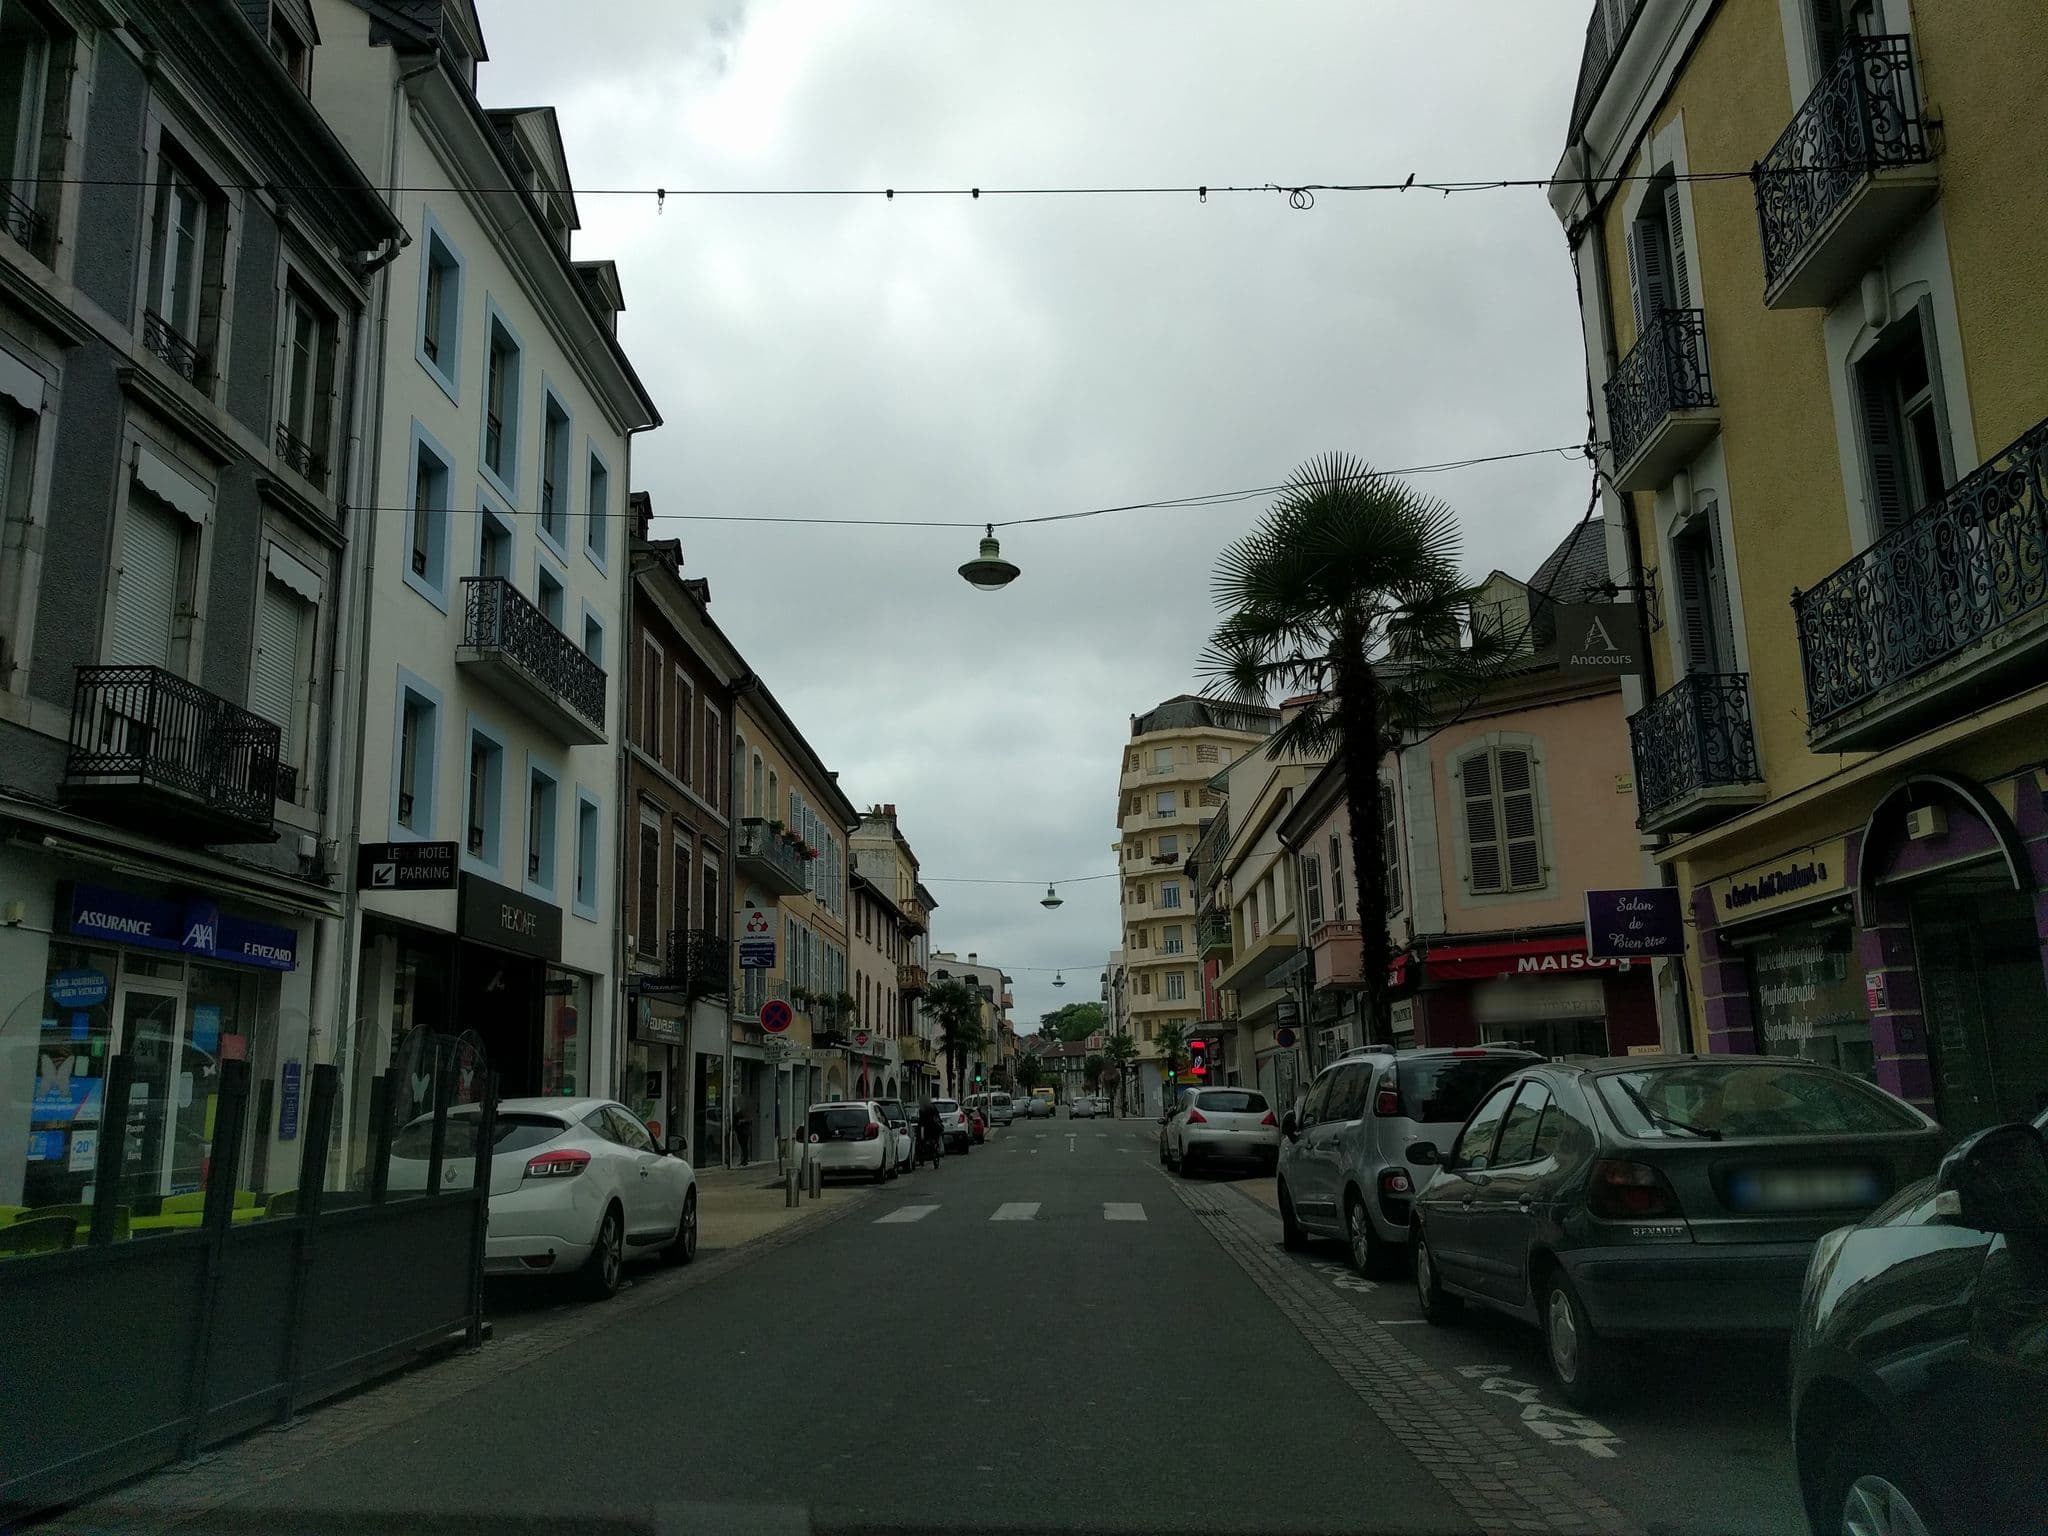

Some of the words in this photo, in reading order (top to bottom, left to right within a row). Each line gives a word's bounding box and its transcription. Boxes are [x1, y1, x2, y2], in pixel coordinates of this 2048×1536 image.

[1570, 654, 1633, 666] Anacours
[387, 847, 401, 860] LE
[418, 846, 452, 860] HOTEL
[399, 866, 450, 880] PARKING
[1616, 896, 1655, 914] Salon
[77, 909, 153, 937] ASSURANCE
[1628, 916, 1644, 930] de
[181, 922, 215, 951] AXA
[1608, 932, 1645, 950] Bien
[1632, 1225, 1685, 1238] RENAULT
